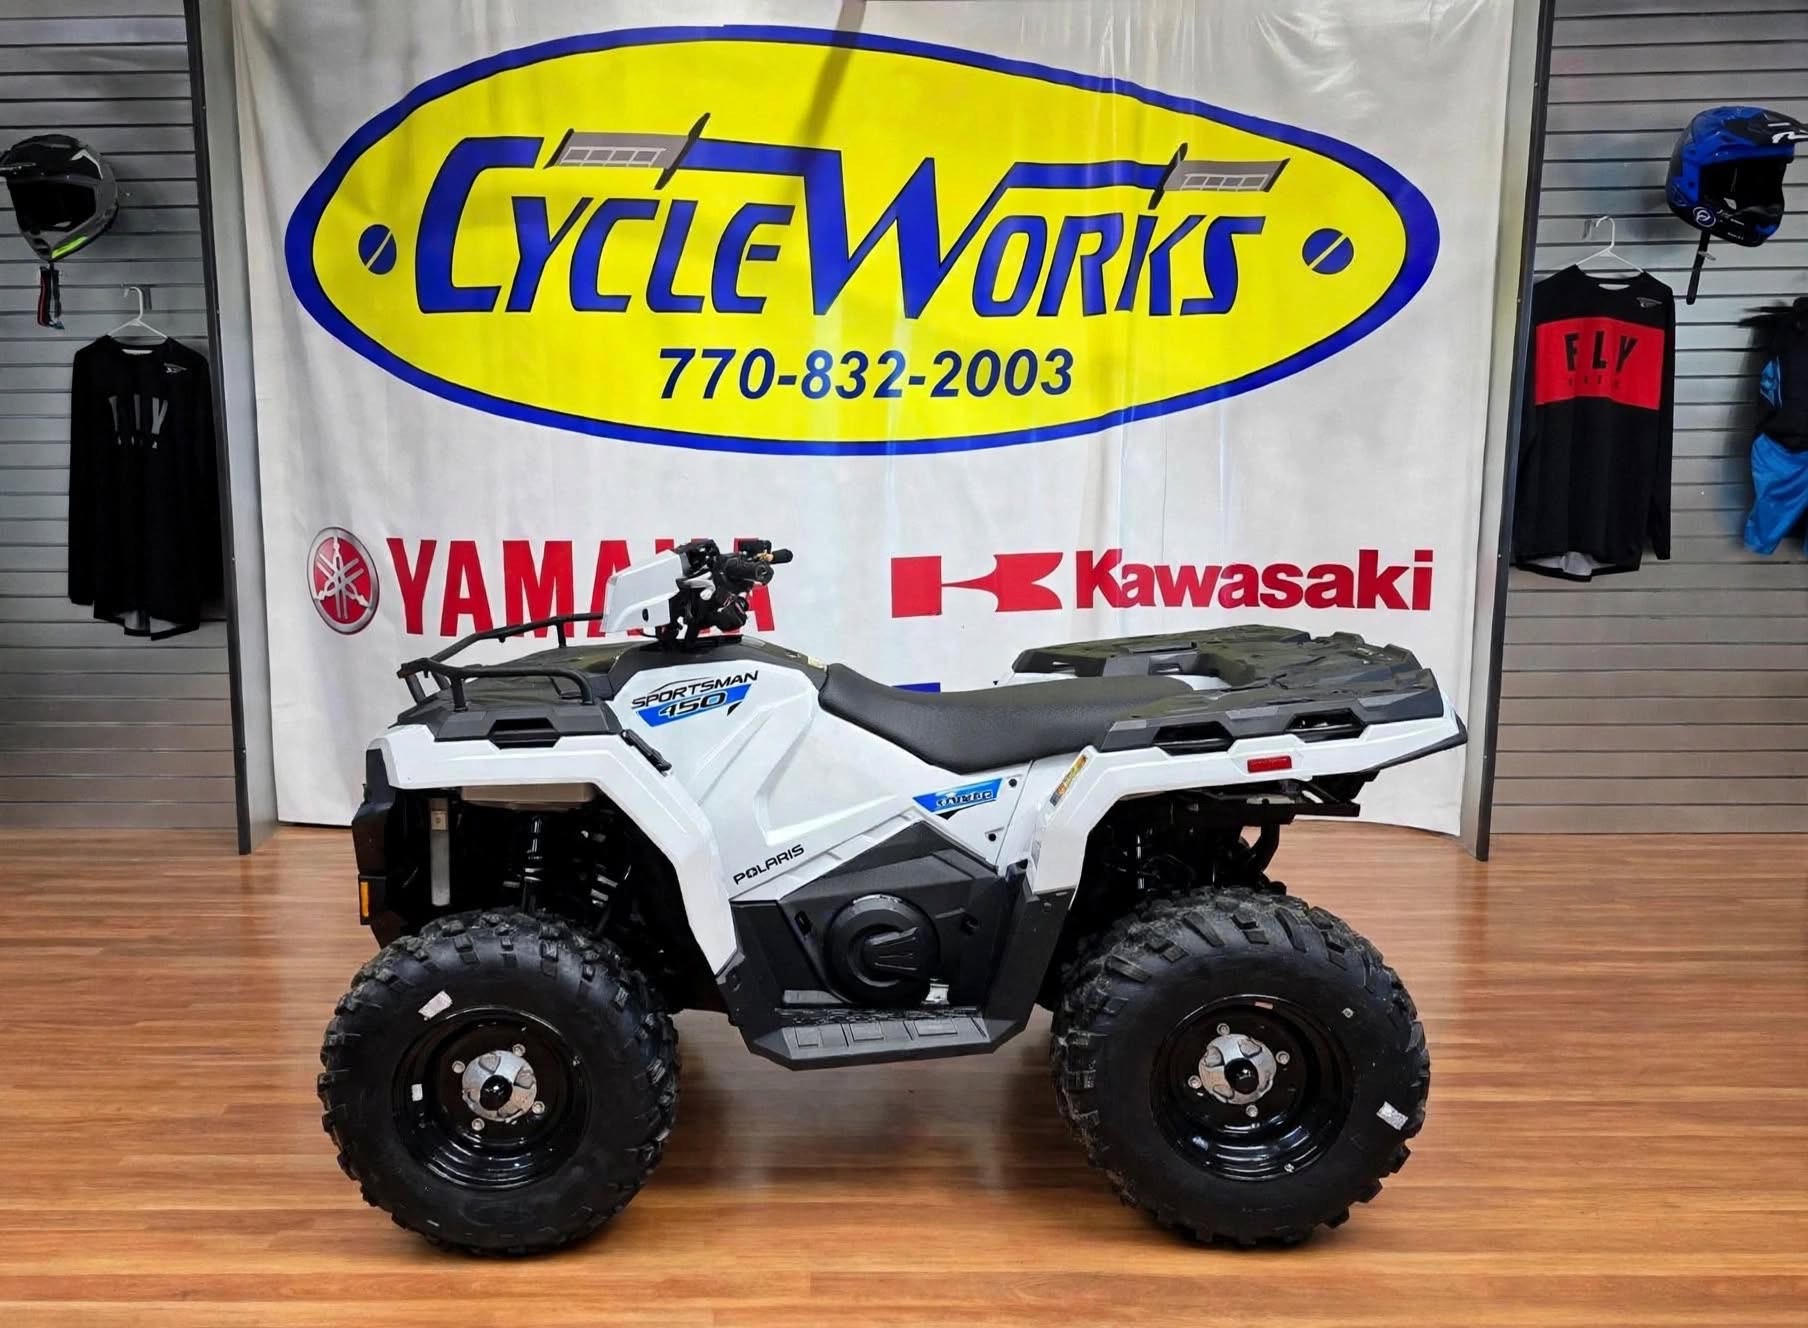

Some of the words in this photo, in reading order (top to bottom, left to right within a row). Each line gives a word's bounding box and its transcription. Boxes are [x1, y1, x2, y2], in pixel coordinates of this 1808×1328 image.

[1564, 331, 1639, 373] FLY
[658, 348, 1074, 399] 770-832-2003
[385, 537, 776, 638] YAMA
[1075, 548, 1434, 611] Kawasaki
[631, 669, 759, 709] SPORTSMAN
[659, 691, 726, 717] 450
[733, 843, 805, 885] POLARIS
